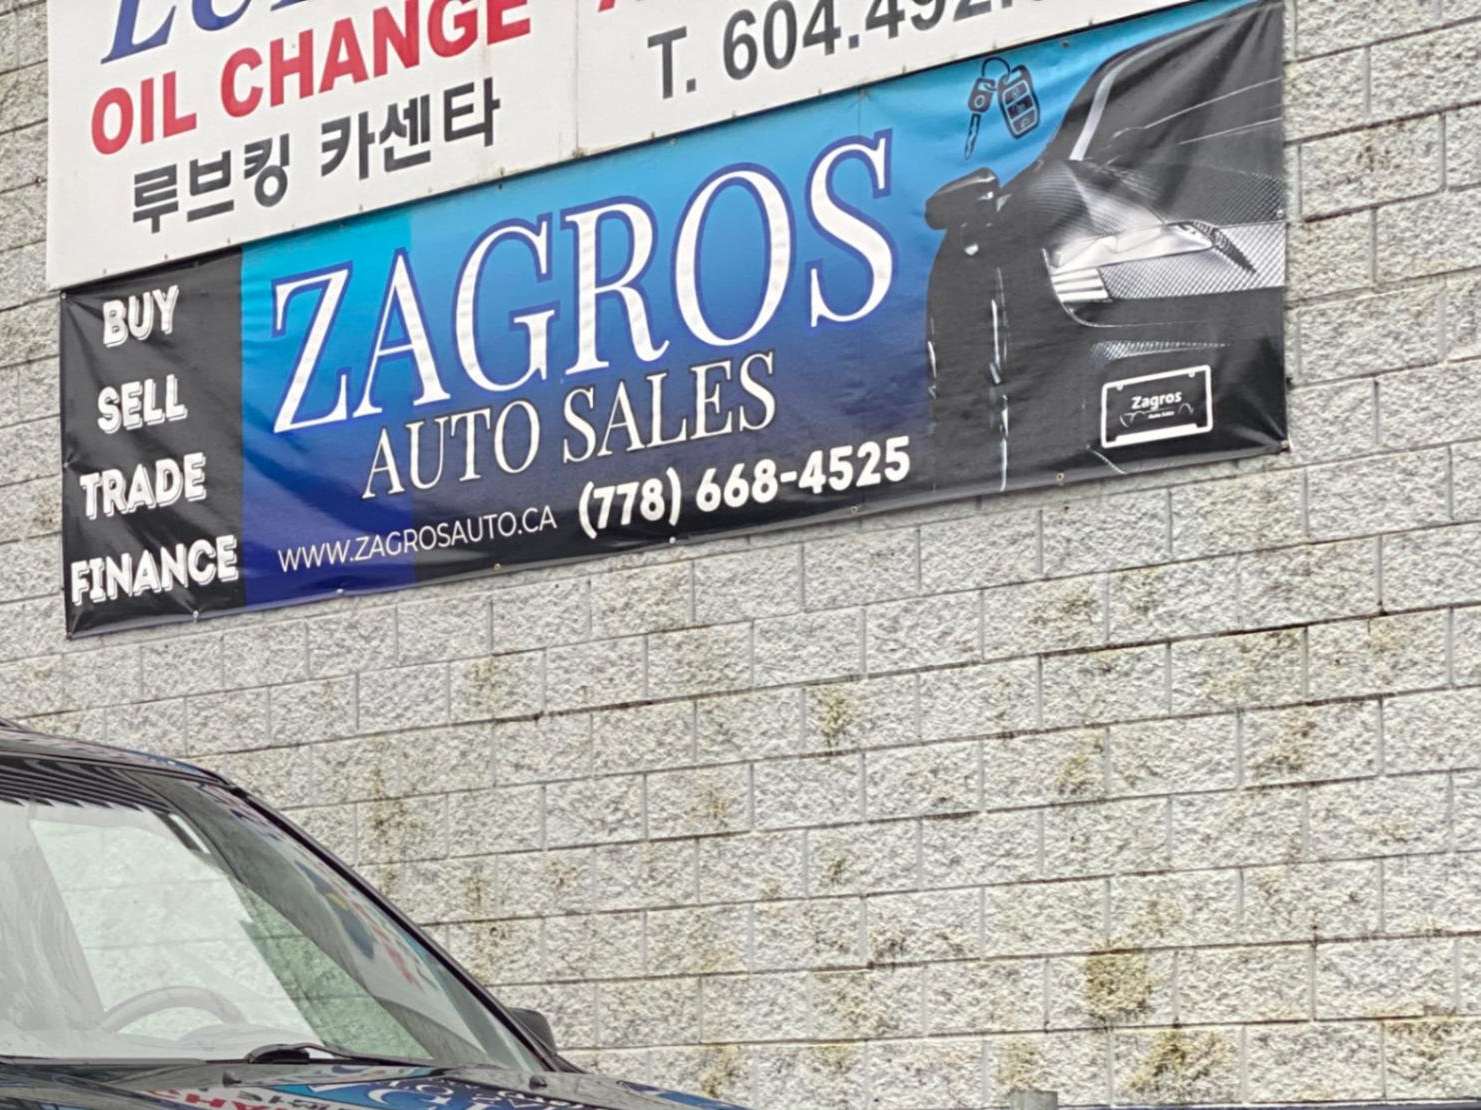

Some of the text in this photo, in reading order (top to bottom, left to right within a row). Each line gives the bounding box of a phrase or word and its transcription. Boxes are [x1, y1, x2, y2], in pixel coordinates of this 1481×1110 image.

[91, 71, 198, 155] OIL
[220, 0, 531, 118] CHANGE
[647, 26, 696, 99] T.
[132, 77, 501, 234] 루브킹 카센타
[102, 285, 180, 347] BUY
[270, 129, 894, 434] ZAGROS
[97, 374, 187, 434] SELL
[361, 350, 776, 500] AUTO SALES
[1131, 391, 1182, 410] Zagros
[79, 452, 207, 520] TRADE
[579, 435, 910, 538] (778) 668-4525
[70, 535, 239, 604] FINANCE
[278, 505, 558, 573] WWW.ZAGROSAUTO.CA
